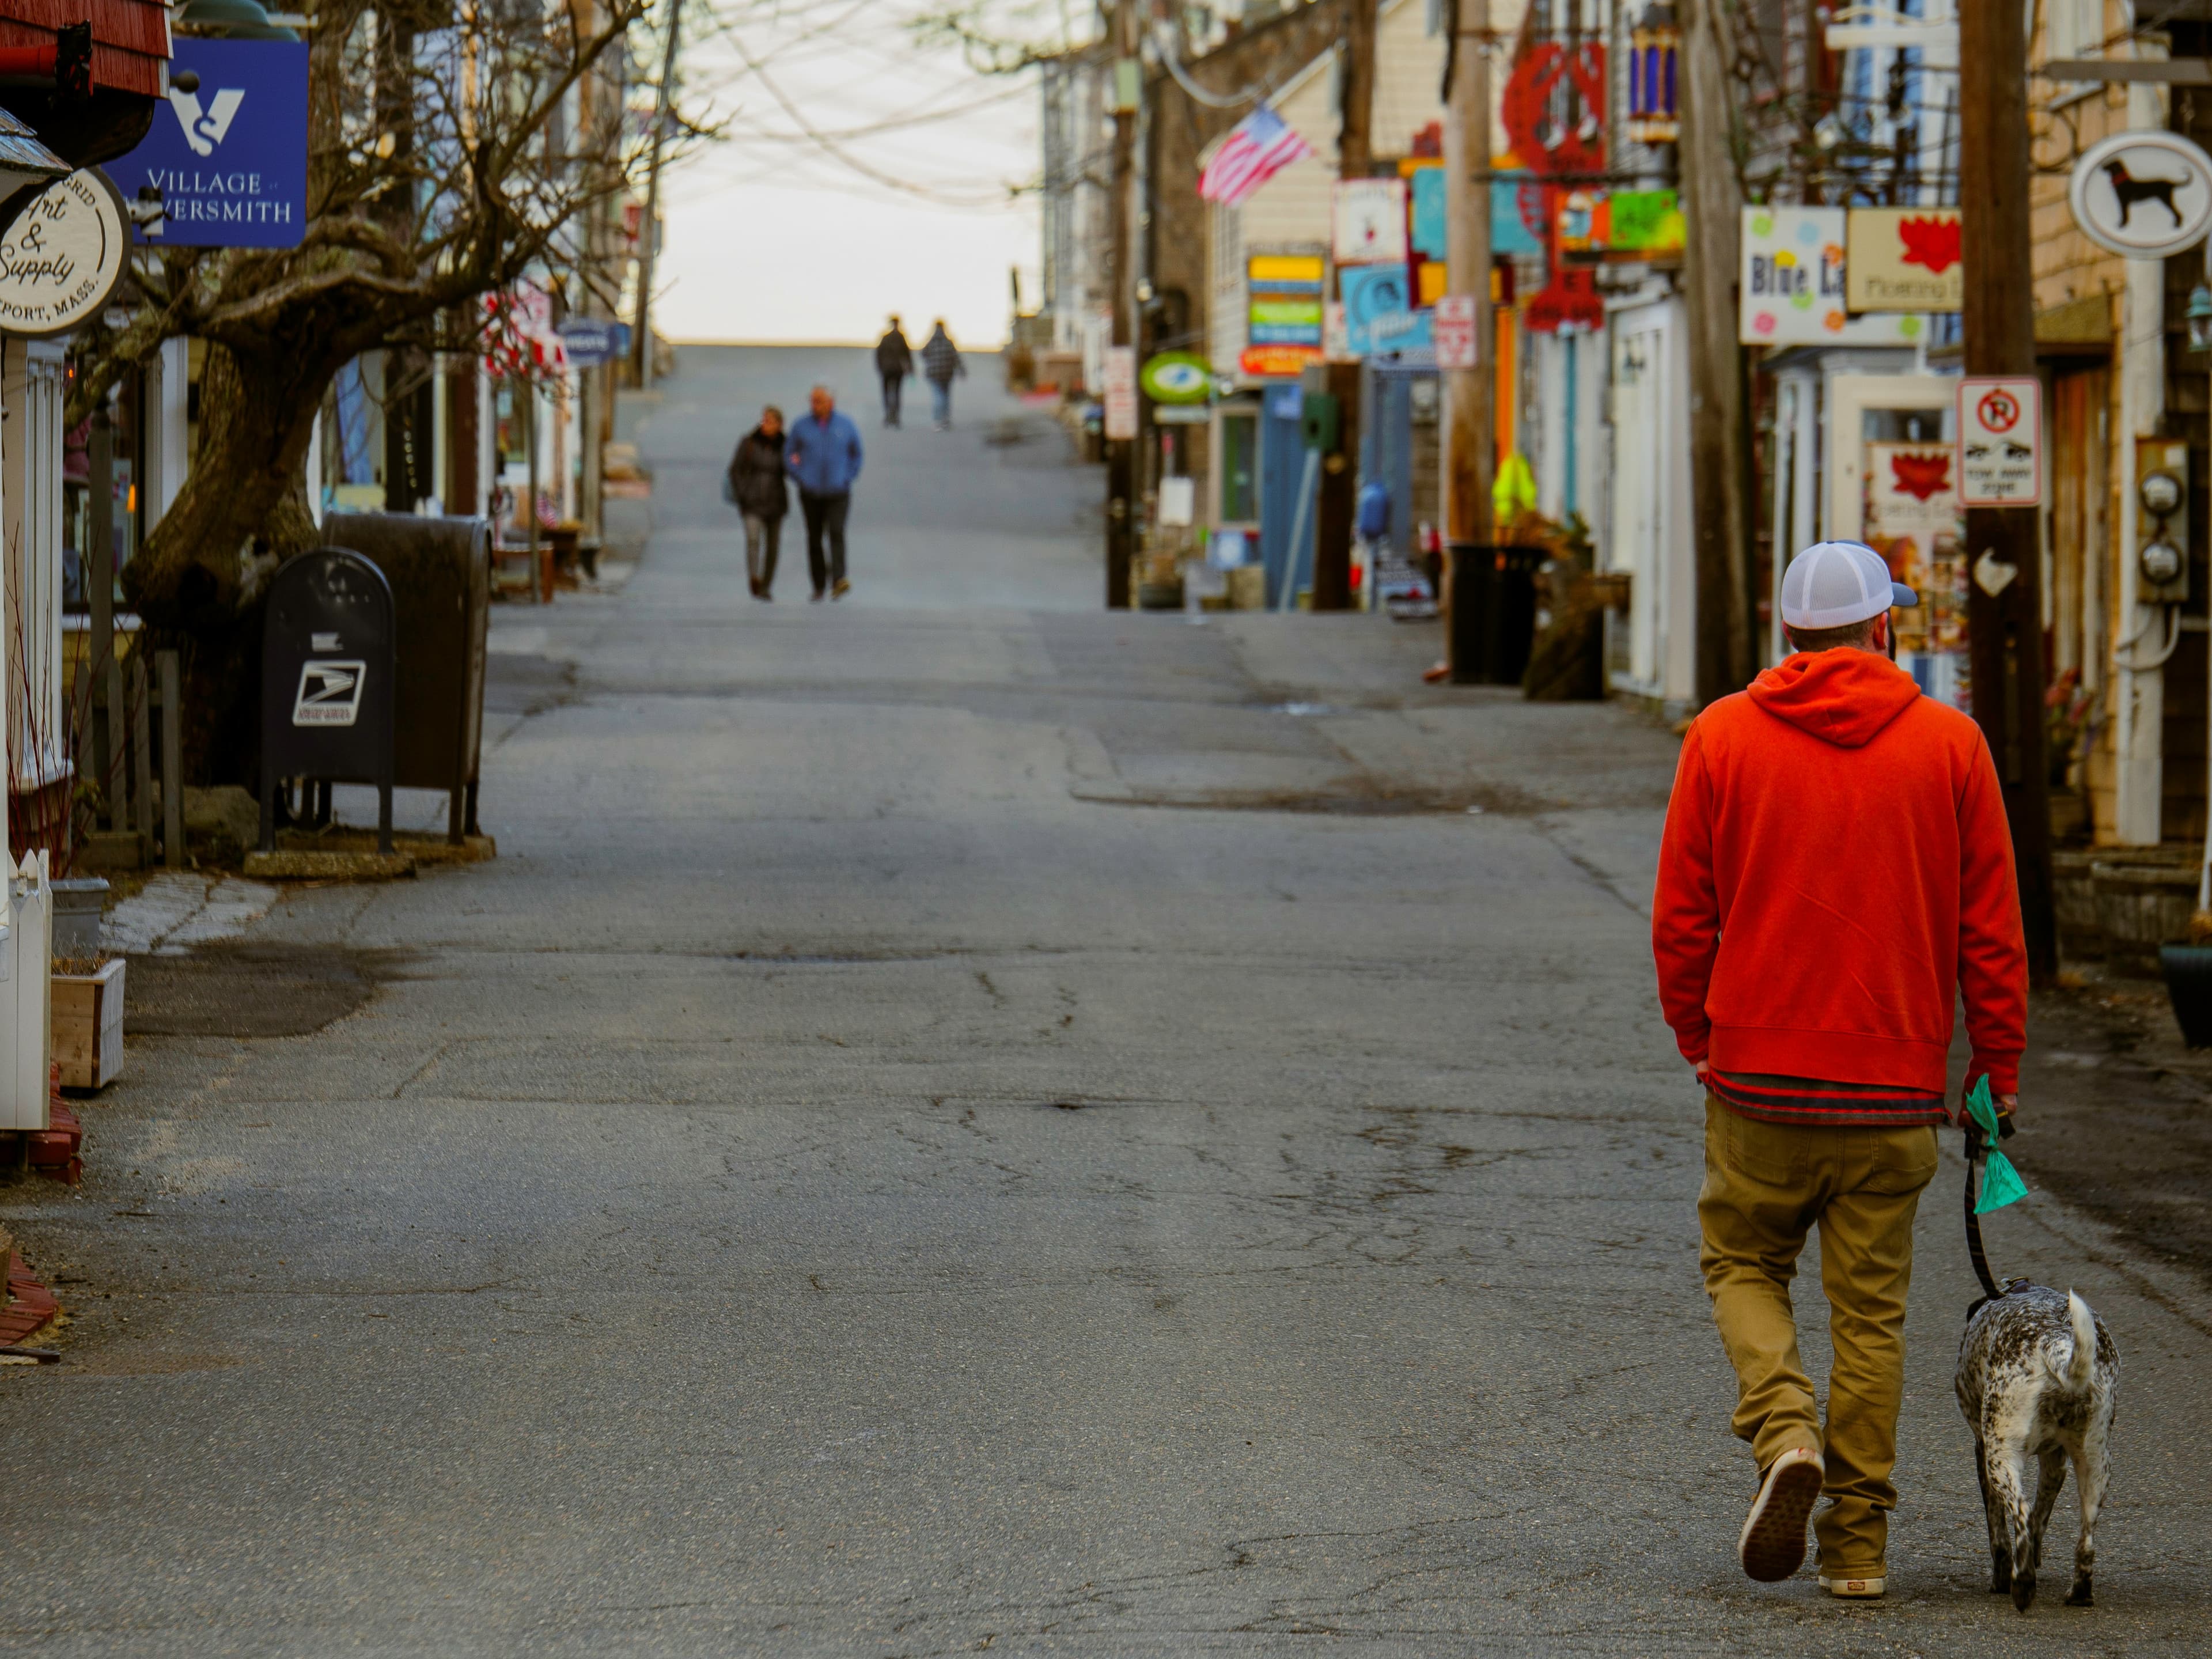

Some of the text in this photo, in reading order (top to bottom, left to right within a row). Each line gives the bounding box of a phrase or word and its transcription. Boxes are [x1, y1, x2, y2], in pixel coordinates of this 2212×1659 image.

[147, 168, 261, 195] VILLAGE
[20, 222, 47, 253] &
[0, 244, 75, 286] Supply
[1751, 255, 1808, 297] Blue
[0, 278, 99, 321] PORT, MASS.
